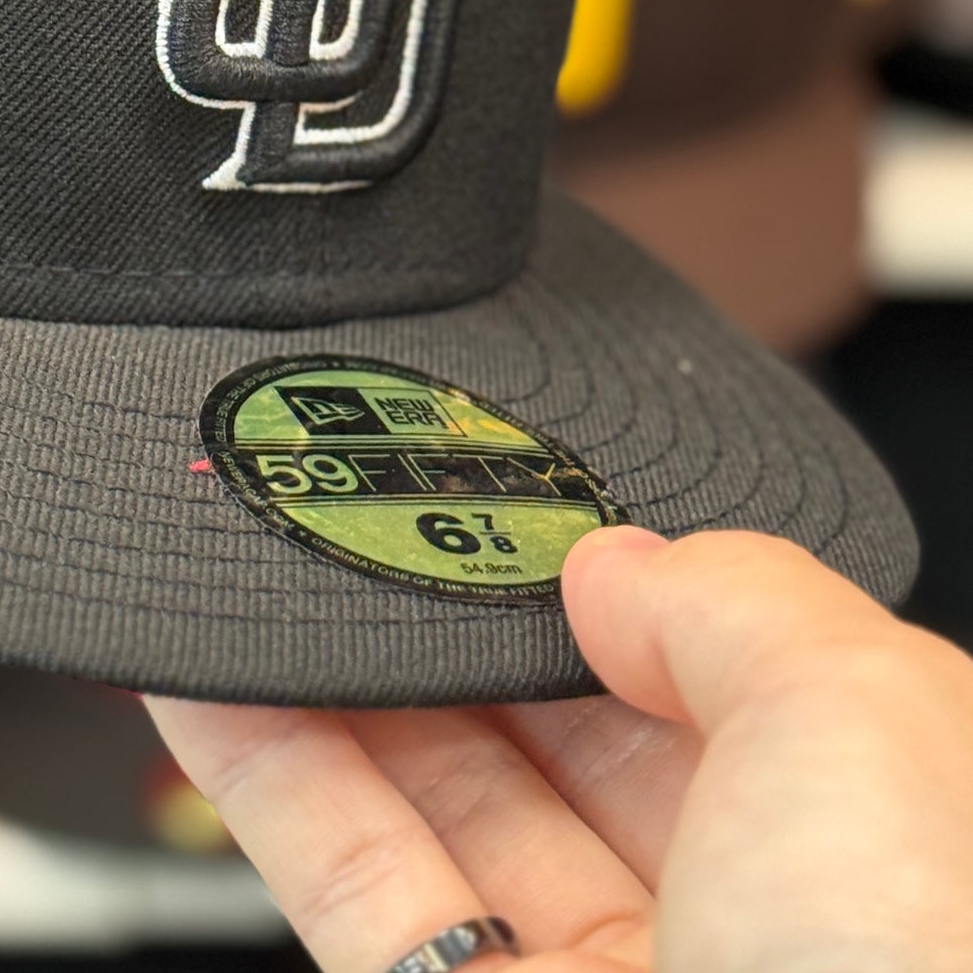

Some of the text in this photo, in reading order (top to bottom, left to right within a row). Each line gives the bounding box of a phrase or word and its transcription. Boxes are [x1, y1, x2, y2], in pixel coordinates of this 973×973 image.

[374, 396, 436, 413] NEW
[385, 411, 449, 429] ERA
[416, 512, 481, 555] 6
[413, 576, 432, 587] OF
[438, 581, 467, 593] THE
